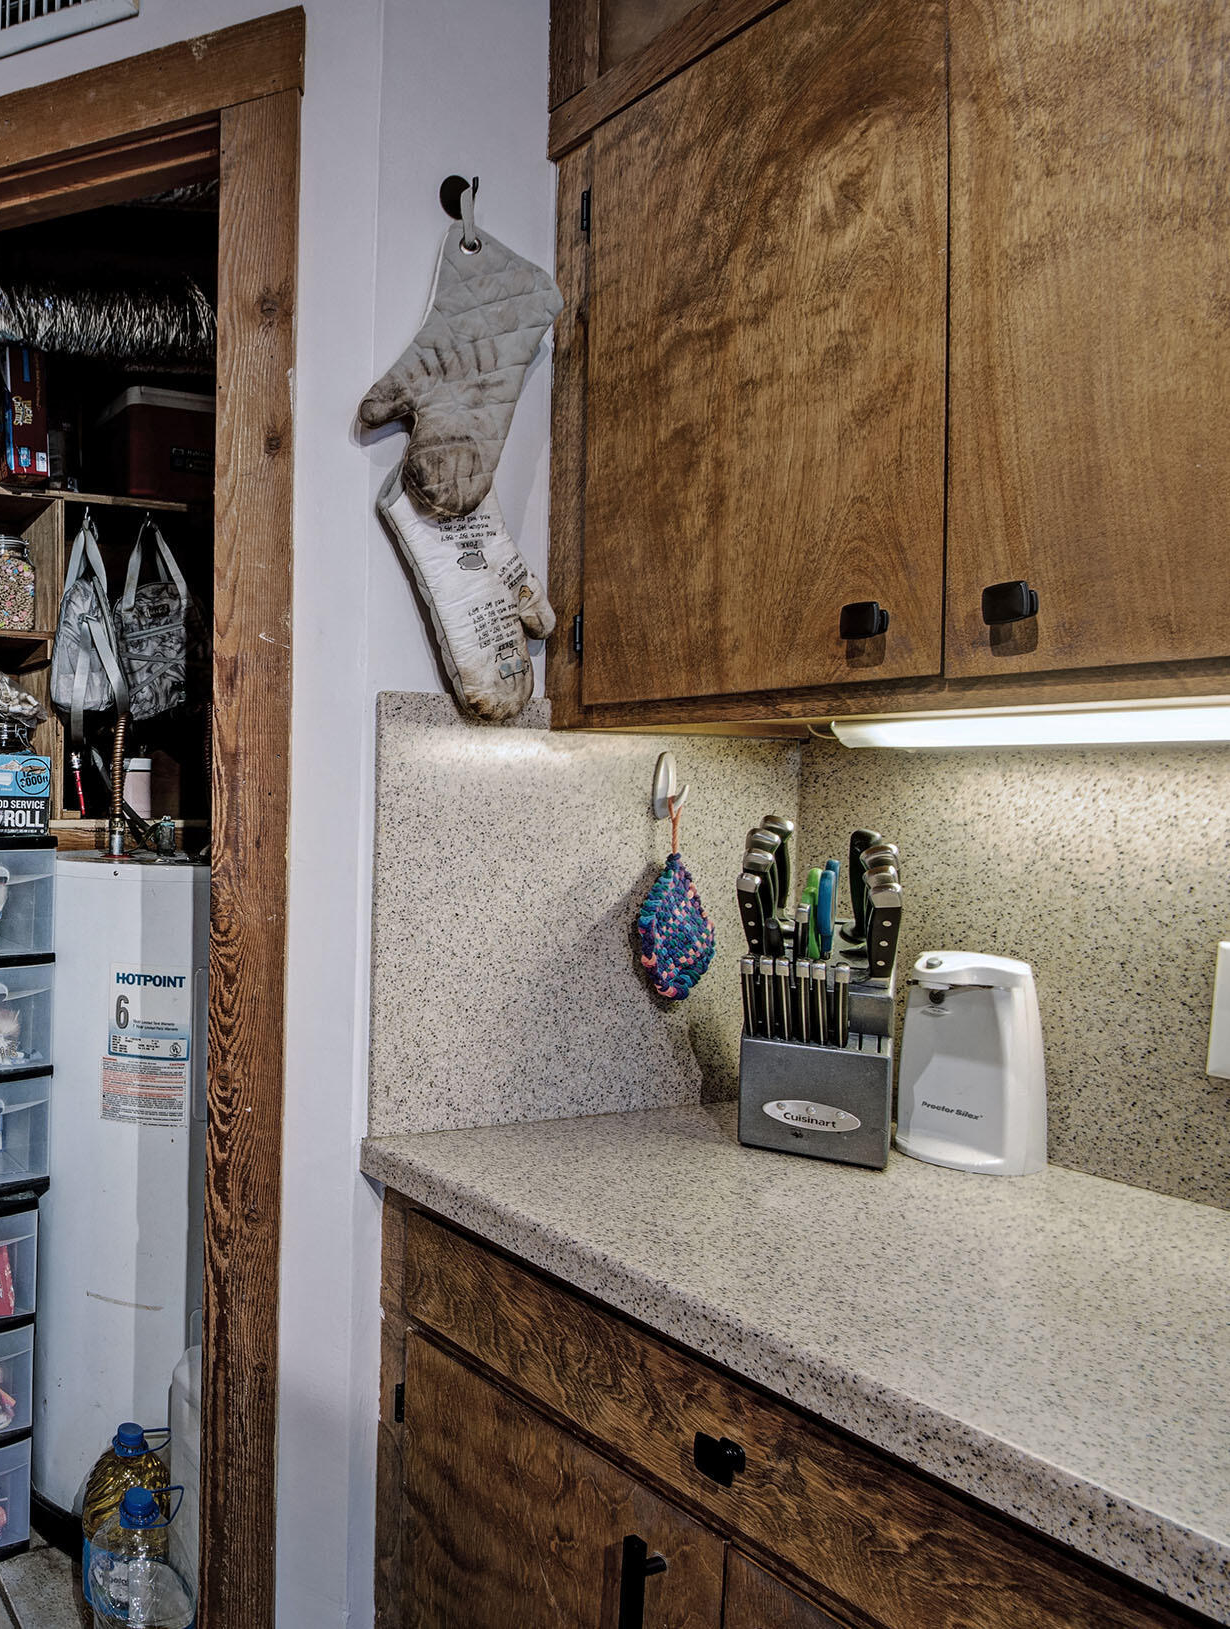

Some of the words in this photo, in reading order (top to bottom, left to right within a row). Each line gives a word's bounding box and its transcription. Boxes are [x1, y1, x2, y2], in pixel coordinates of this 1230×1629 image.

[12, 395, 24, 426] Charms
[22, 399, 33, 425] Lucky
[10, 800, 45, 809] SERVICE
[3, 809, 45, 828] ROLL
[116, 972, 186, 988] HOTPOINT
[115, 994, 130, 1030] 6
[921, 1100, 955, 1116] Proctor
[783, 1110, 837, 1129] Cuisinart
